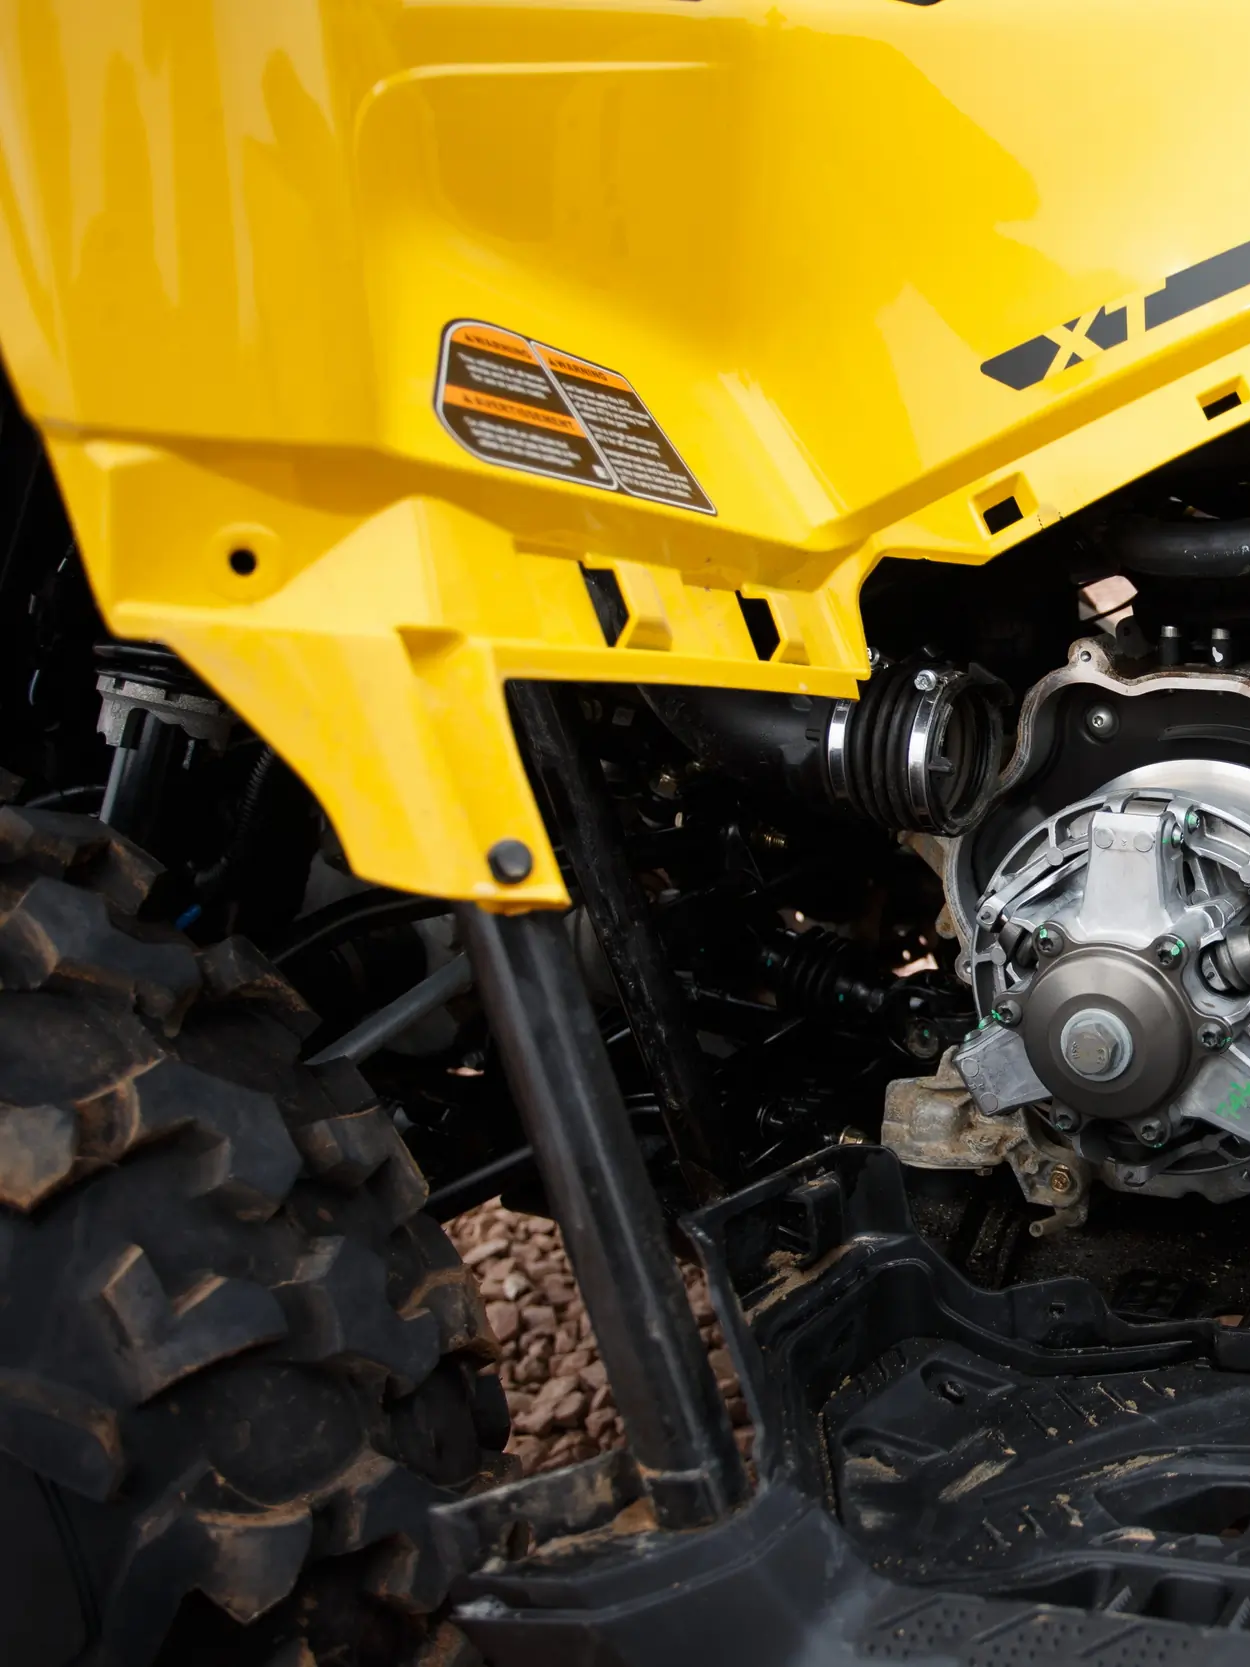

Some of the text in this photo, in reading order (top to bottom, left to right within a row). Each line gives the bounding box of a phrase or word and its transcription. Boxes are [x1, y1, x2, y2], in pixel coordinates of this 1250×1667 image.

[1042, 277, 1166, 380] XT
[557, 360, 608, 382] WARNING
[474, 395, 576, 432] AVERTISSEMENT
